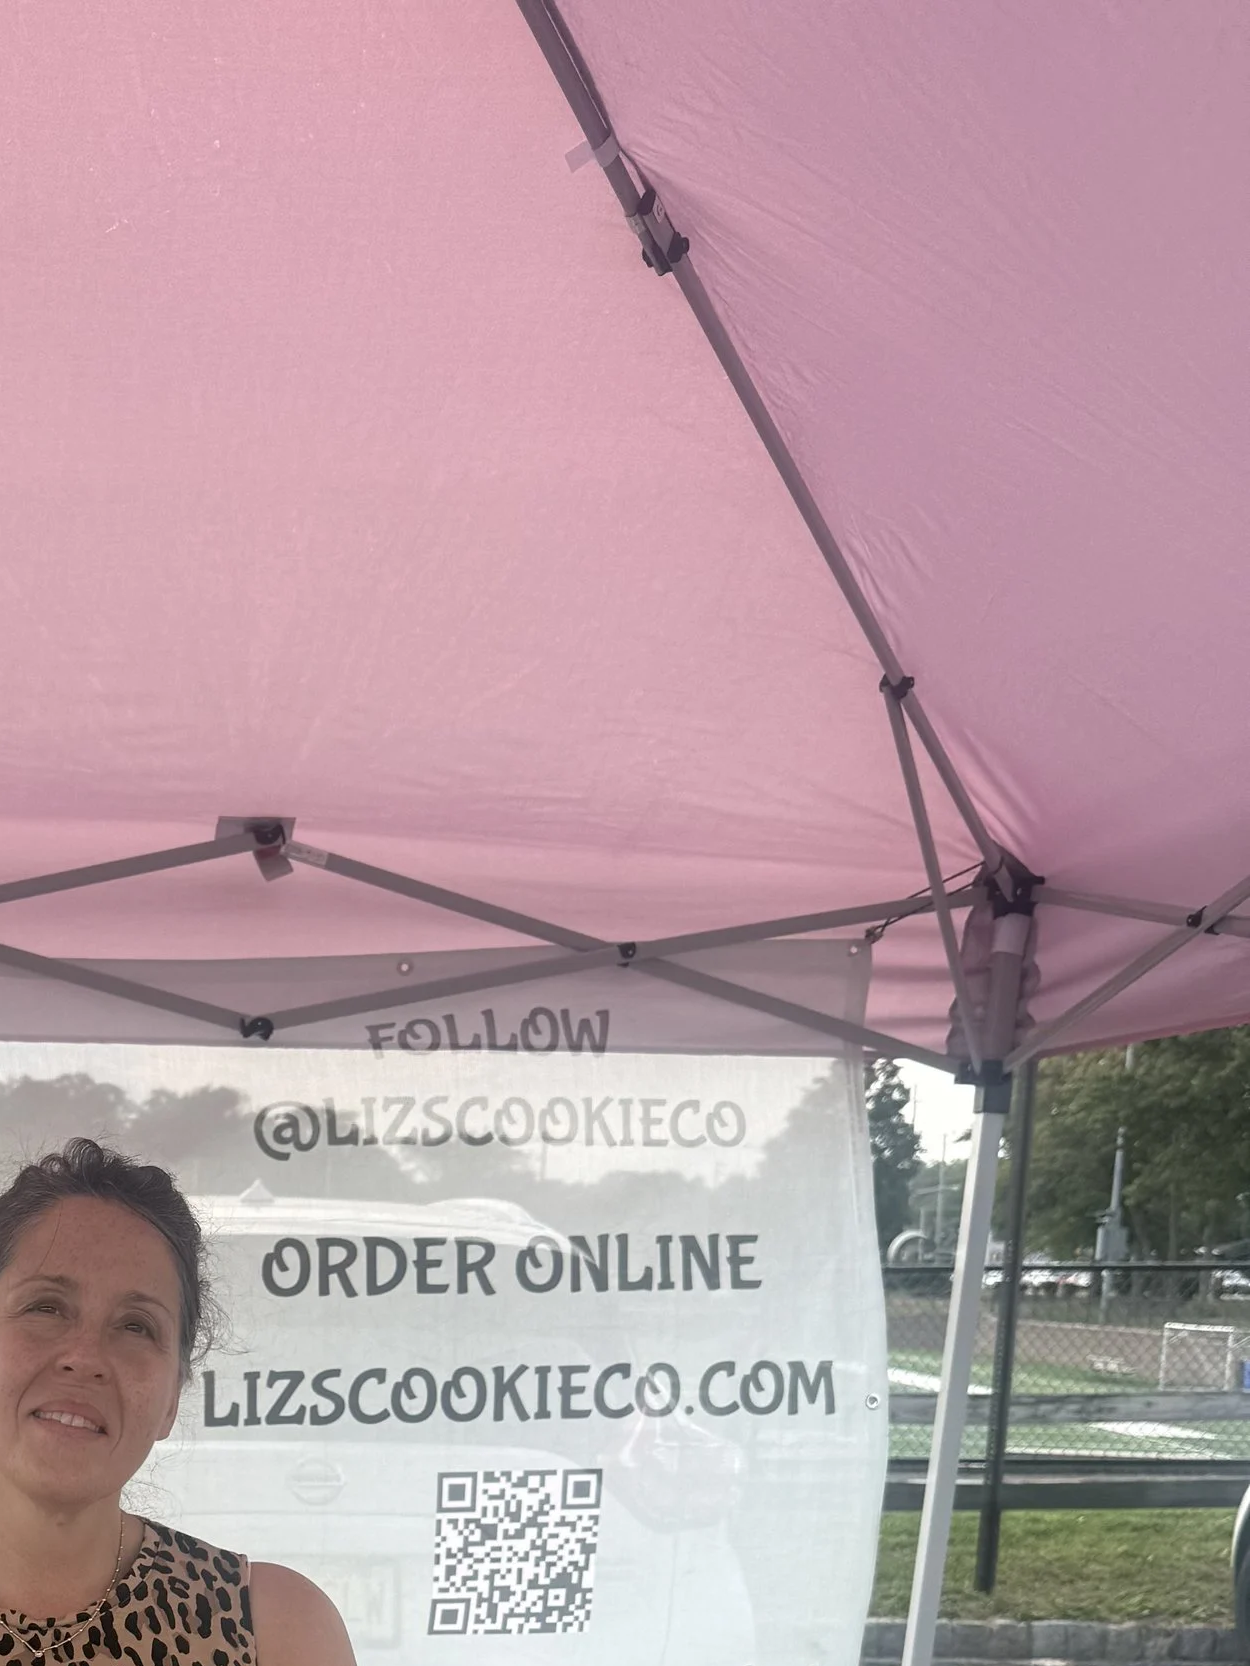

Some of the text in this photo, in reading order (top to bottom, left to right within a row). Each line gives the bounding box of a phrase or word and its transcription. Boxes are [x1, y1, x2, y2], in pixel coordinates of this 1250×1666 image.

[365, 1007, 611, 1059] FOLLOW
[253, 1095, 747, 1161] @LIZSCOOKIECO
[261, 1232, 764, 1299] ORDER ONLINE
[201, 1360, 837, 1428] LIZSCOOKIECO.COM
